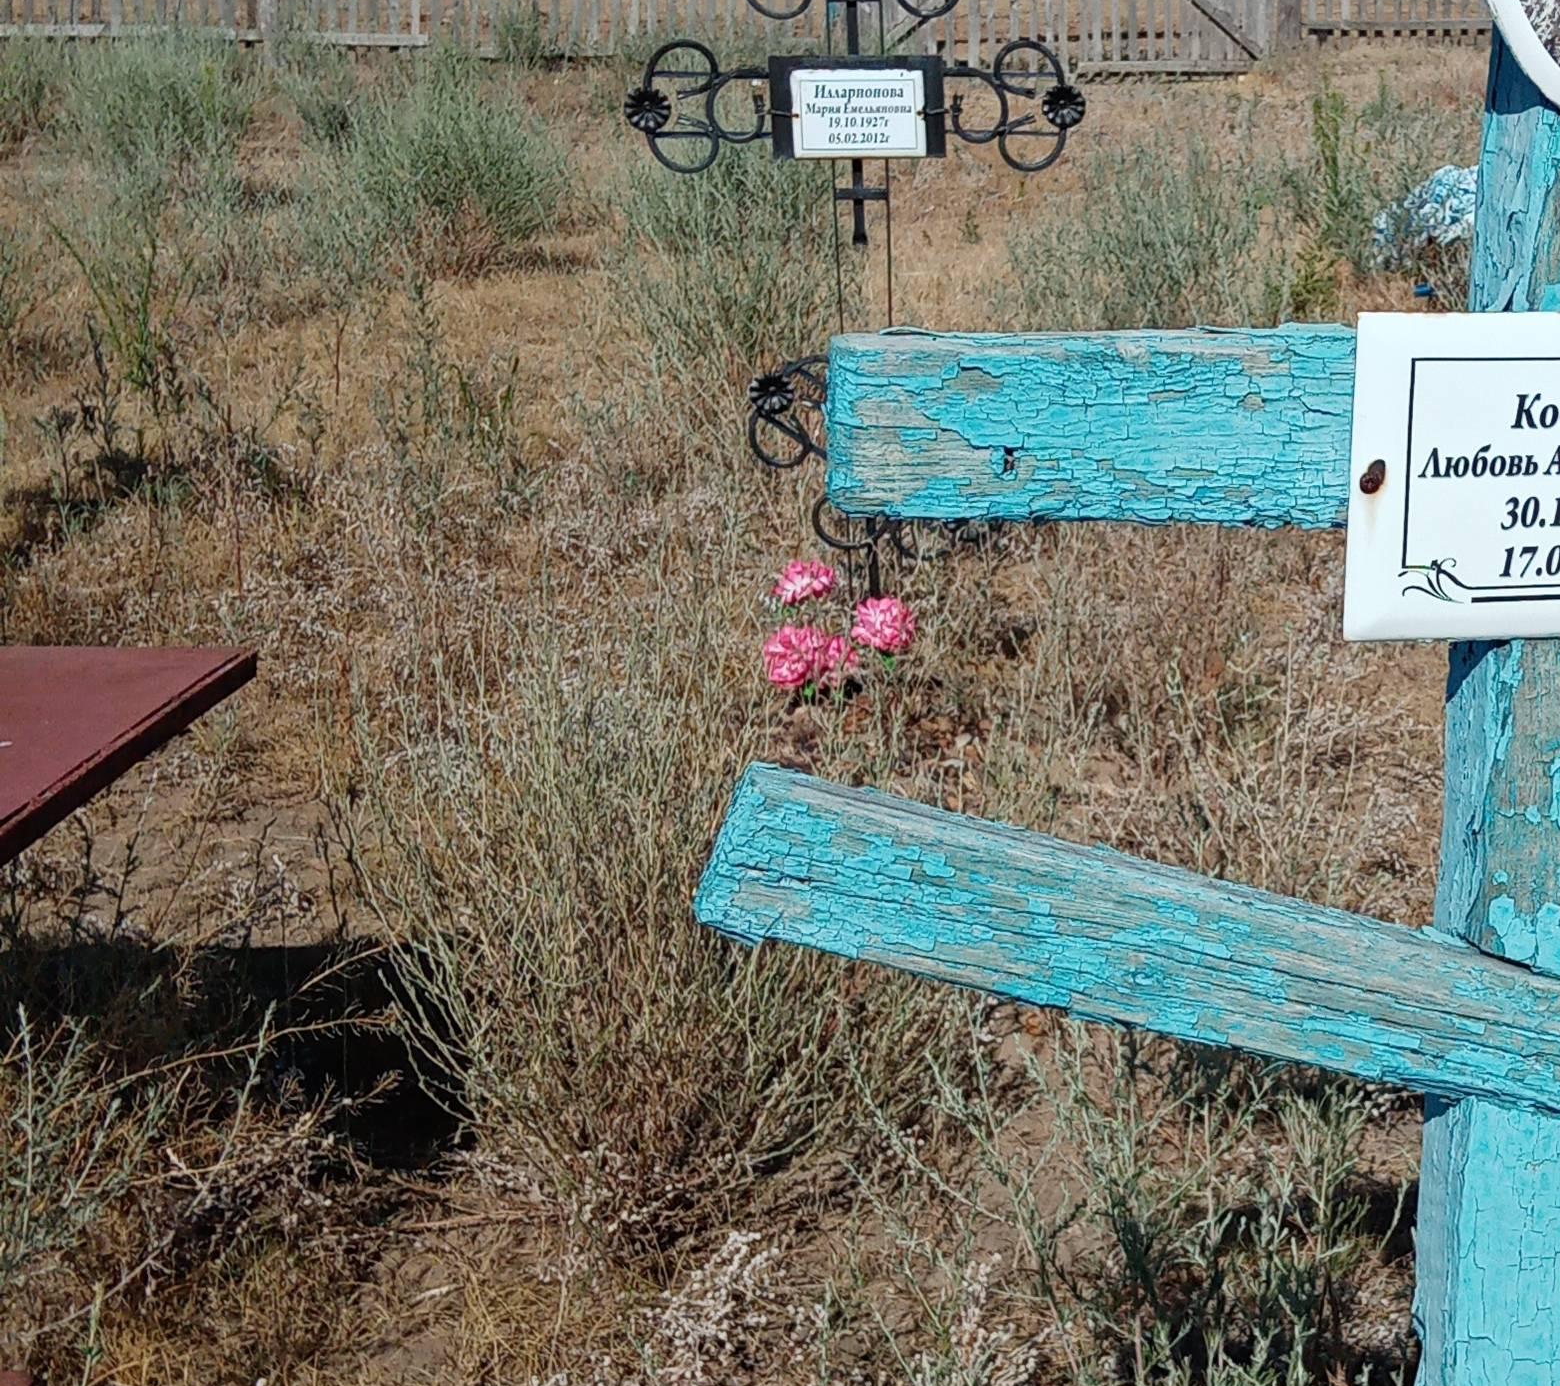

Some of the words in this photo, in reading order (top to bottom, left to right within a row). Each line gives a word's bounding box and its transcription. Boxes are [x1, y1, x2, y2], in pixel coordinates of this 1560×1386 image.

[814, 84, 904, 104] Илларионова
[805, 103, 841, 117] Мария
[843, 102, 912, 114] Емельяновна
[1418, 444, 1539, 479] Любовь
